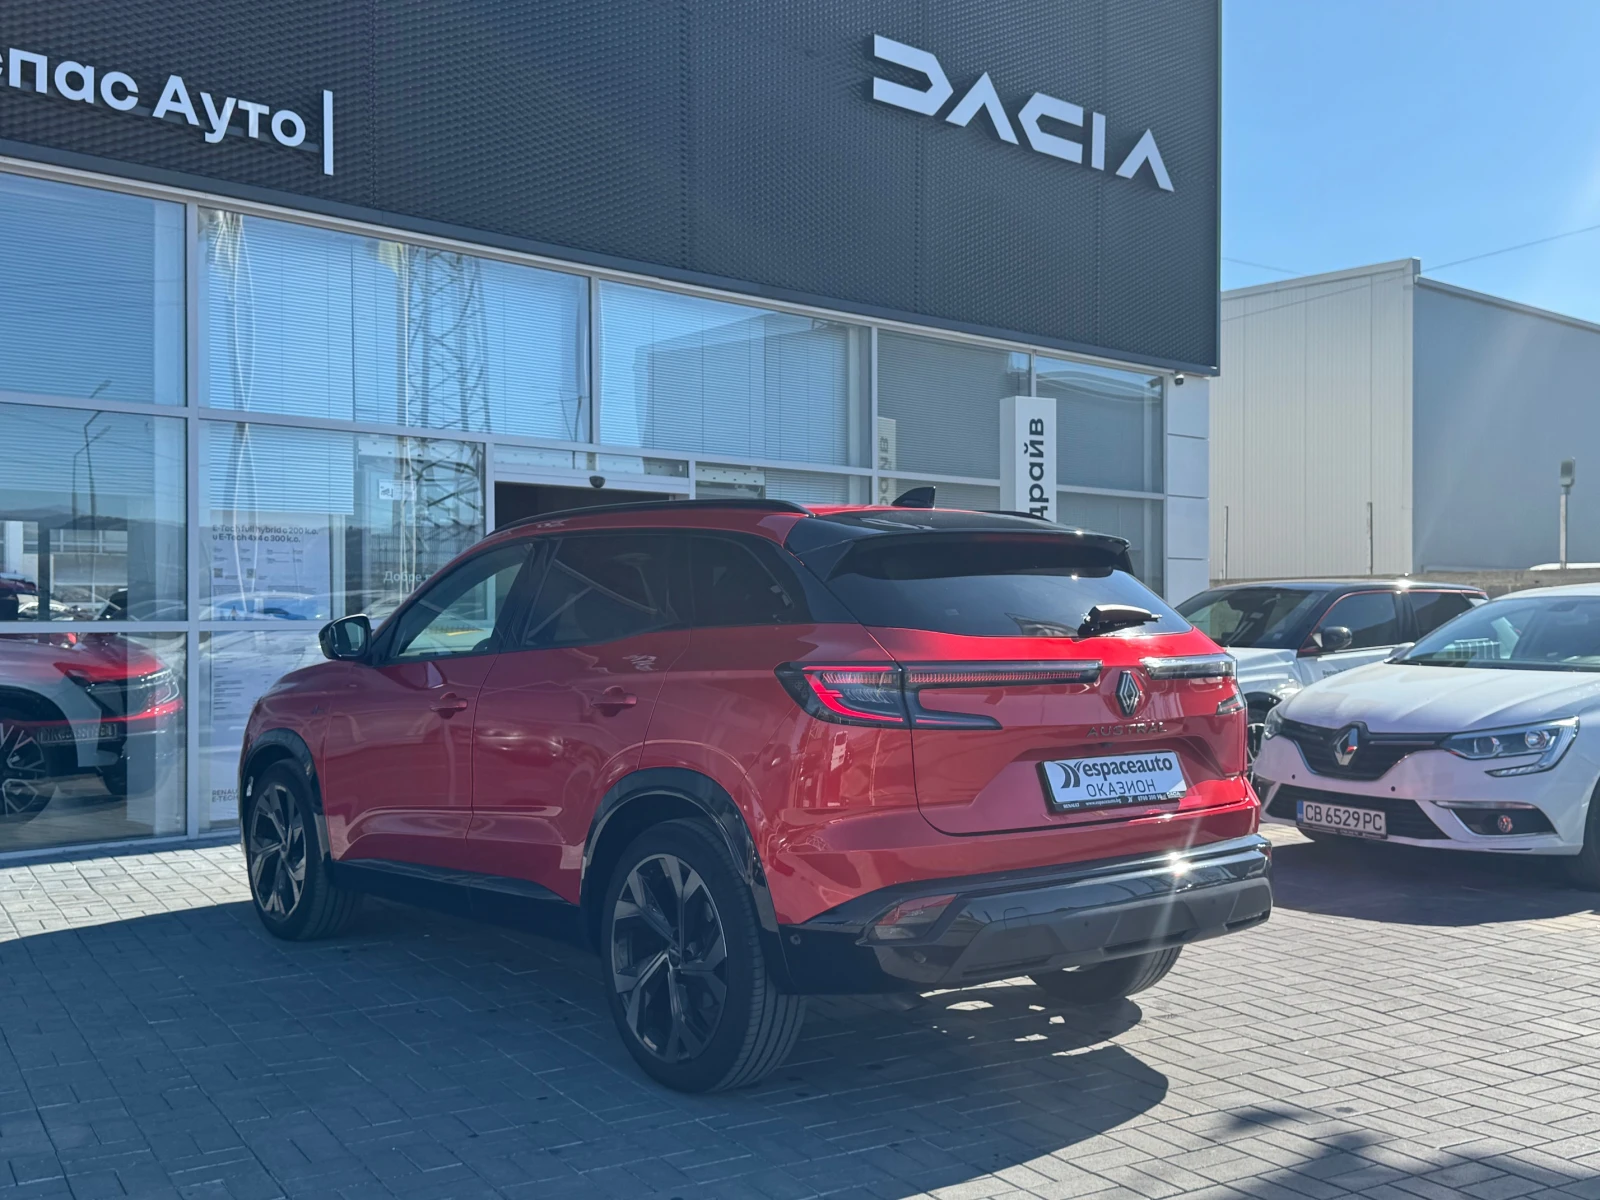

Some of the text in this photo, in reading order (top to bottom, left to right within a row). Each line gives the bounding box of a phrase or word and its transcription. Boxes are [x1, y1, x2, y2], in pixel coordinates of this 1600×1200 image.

[0, 48, 306, 147] пас Ауто
[873, 34, 1175, 192] DACIA
[383, 571, 422, 584] Добре
[1086, 723, 1167, 738] AUSTRAL
[1082, 755, 1173, 781] espaceauto
[1086, 779, 1156, 797] ОКАЗИОН
[1305, 804, 1382, 831] CB 6529 PC
